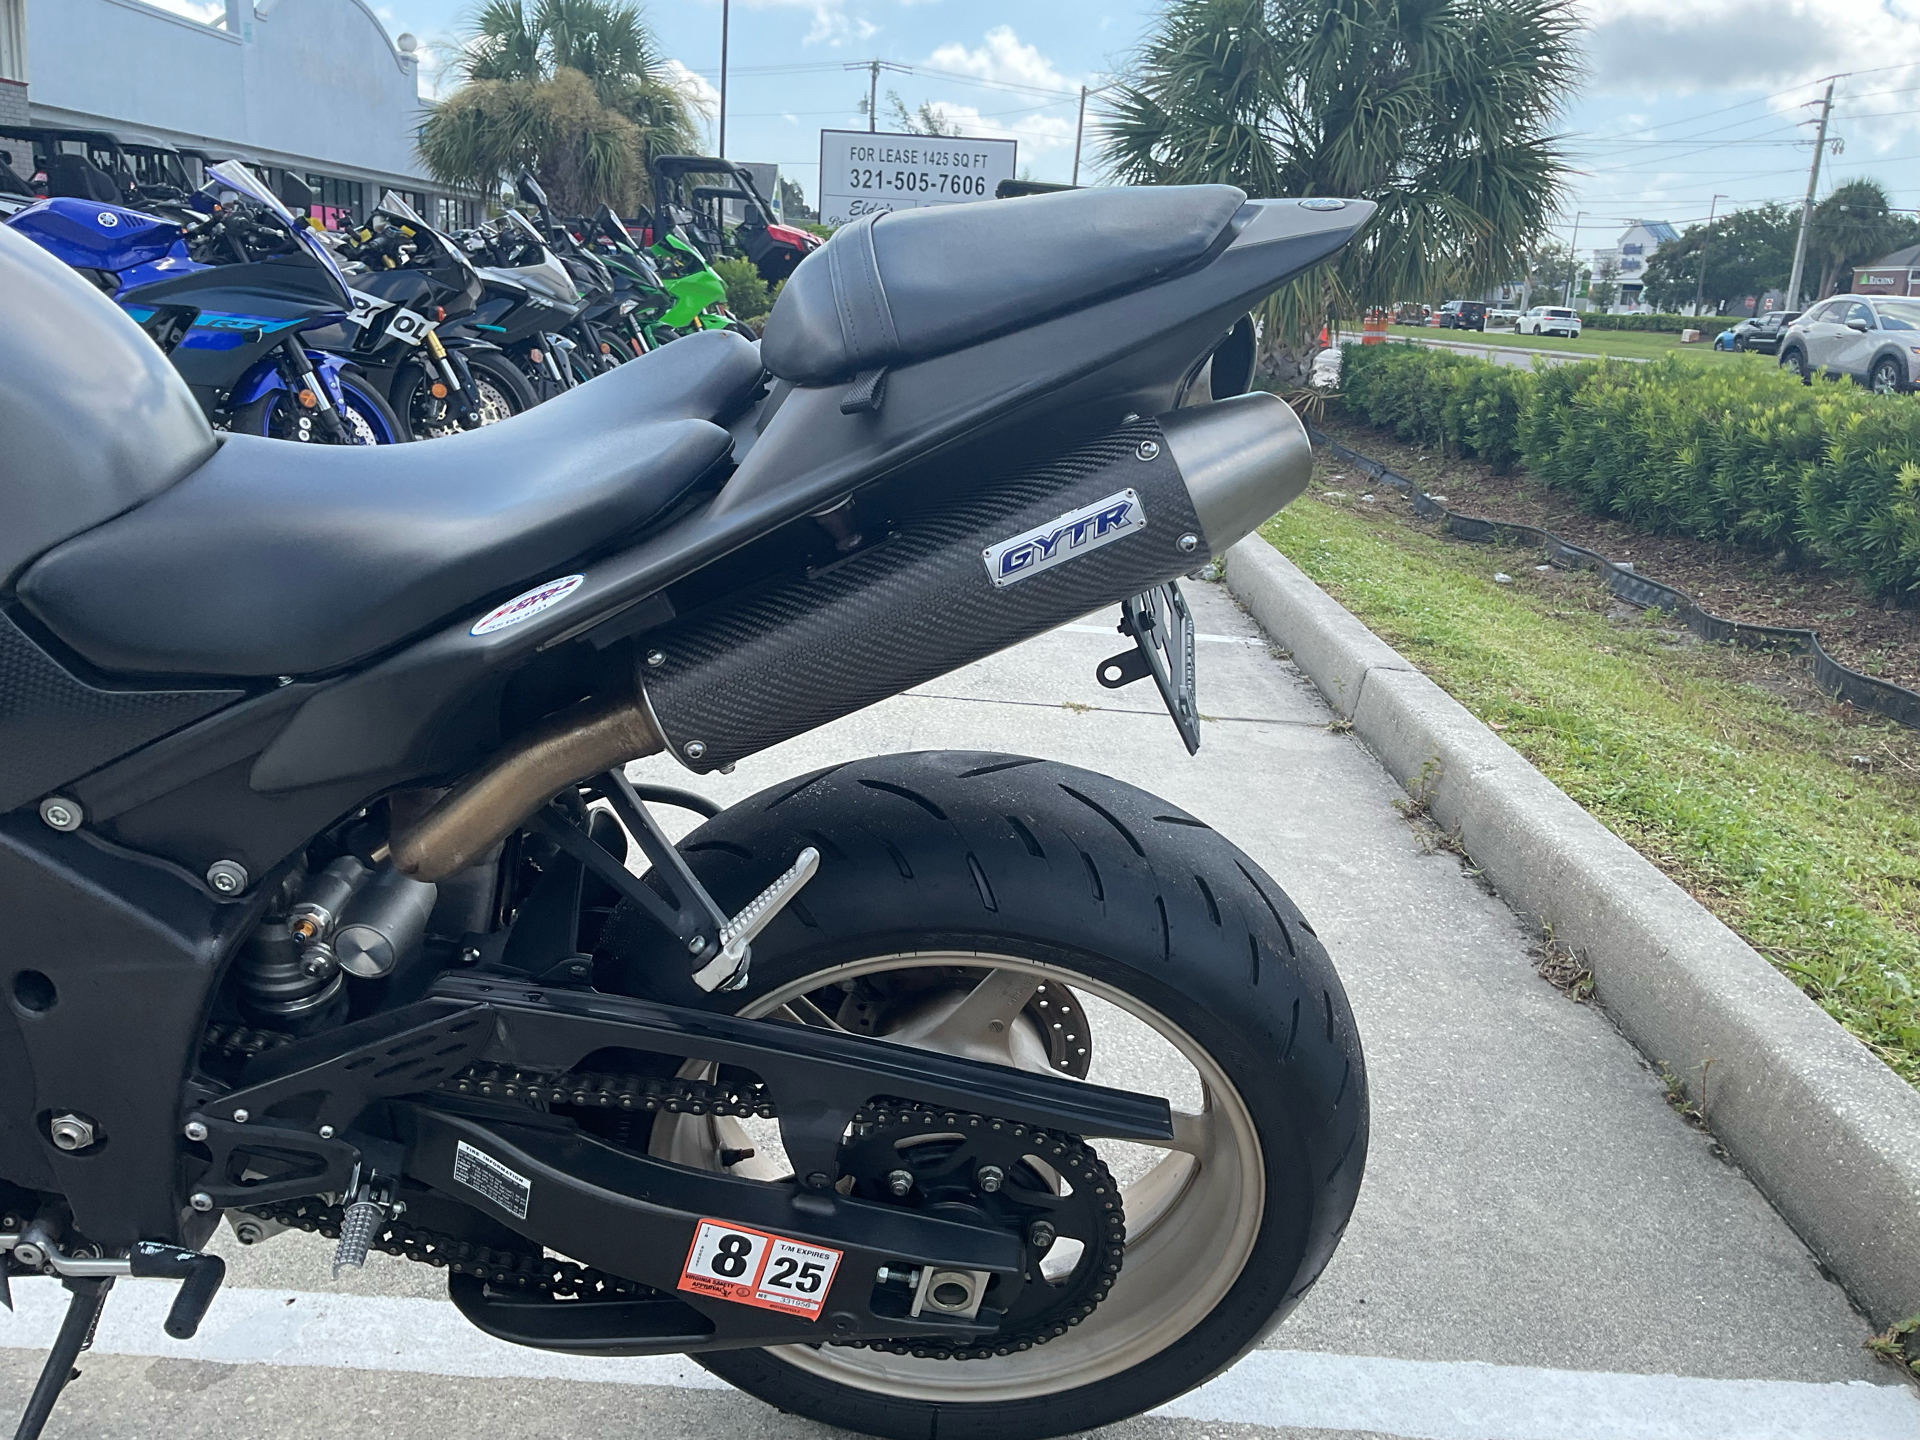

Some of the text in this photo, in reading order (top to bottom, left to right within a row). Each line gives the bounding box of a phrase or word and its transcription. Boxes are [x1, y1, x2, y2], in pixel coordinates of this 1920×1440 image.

[850, 147, 988, 168] FOR LEASE 1425 SQ FT
[850, 168, 986, 196] 321-505-7606
[998, 500, 1133, 578] GYTR
[465, 1146, 480, 1157] TIRE
[482, 1155, 524, 1183] INFORMATION
[711, 1233, 753, 1278] 8
[780, 1244, 831, 1260] T/M EXPIRES
[767, 1256, 826, 1293] 25
